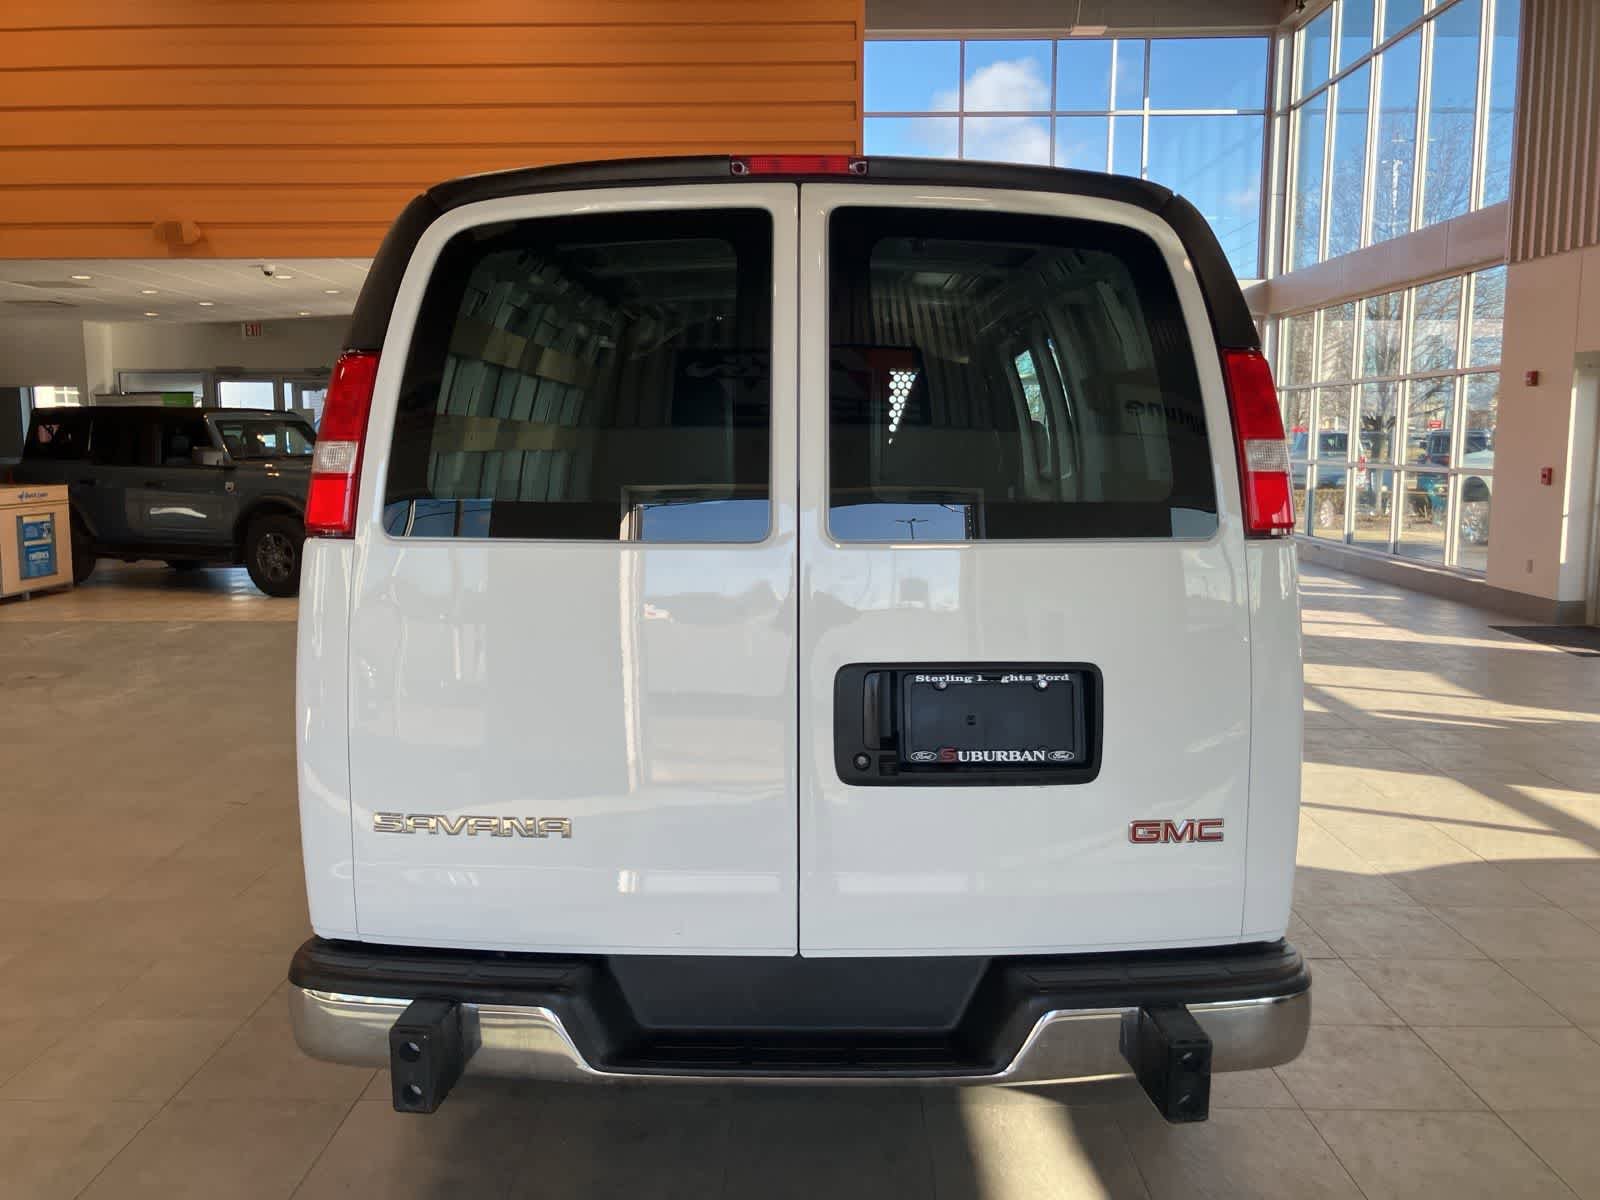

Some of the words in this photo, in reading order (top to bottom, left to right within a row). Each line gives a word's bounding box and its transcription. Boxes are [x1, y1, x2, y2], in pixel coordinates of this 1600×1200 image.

[915, 674, 973, 683] Sterling
[977, 674, 1032, 683] ghts
[1037, 673, 1070, 682] Ford
[913, 751, 934, 760] Ford
[940, 747, 1046, 762] SUBURBAN
[1050, 751, 1072, 760] Ford
[373, 811, 572, 838] SAVANA
[1128, 818, 1224, 843] GMC
